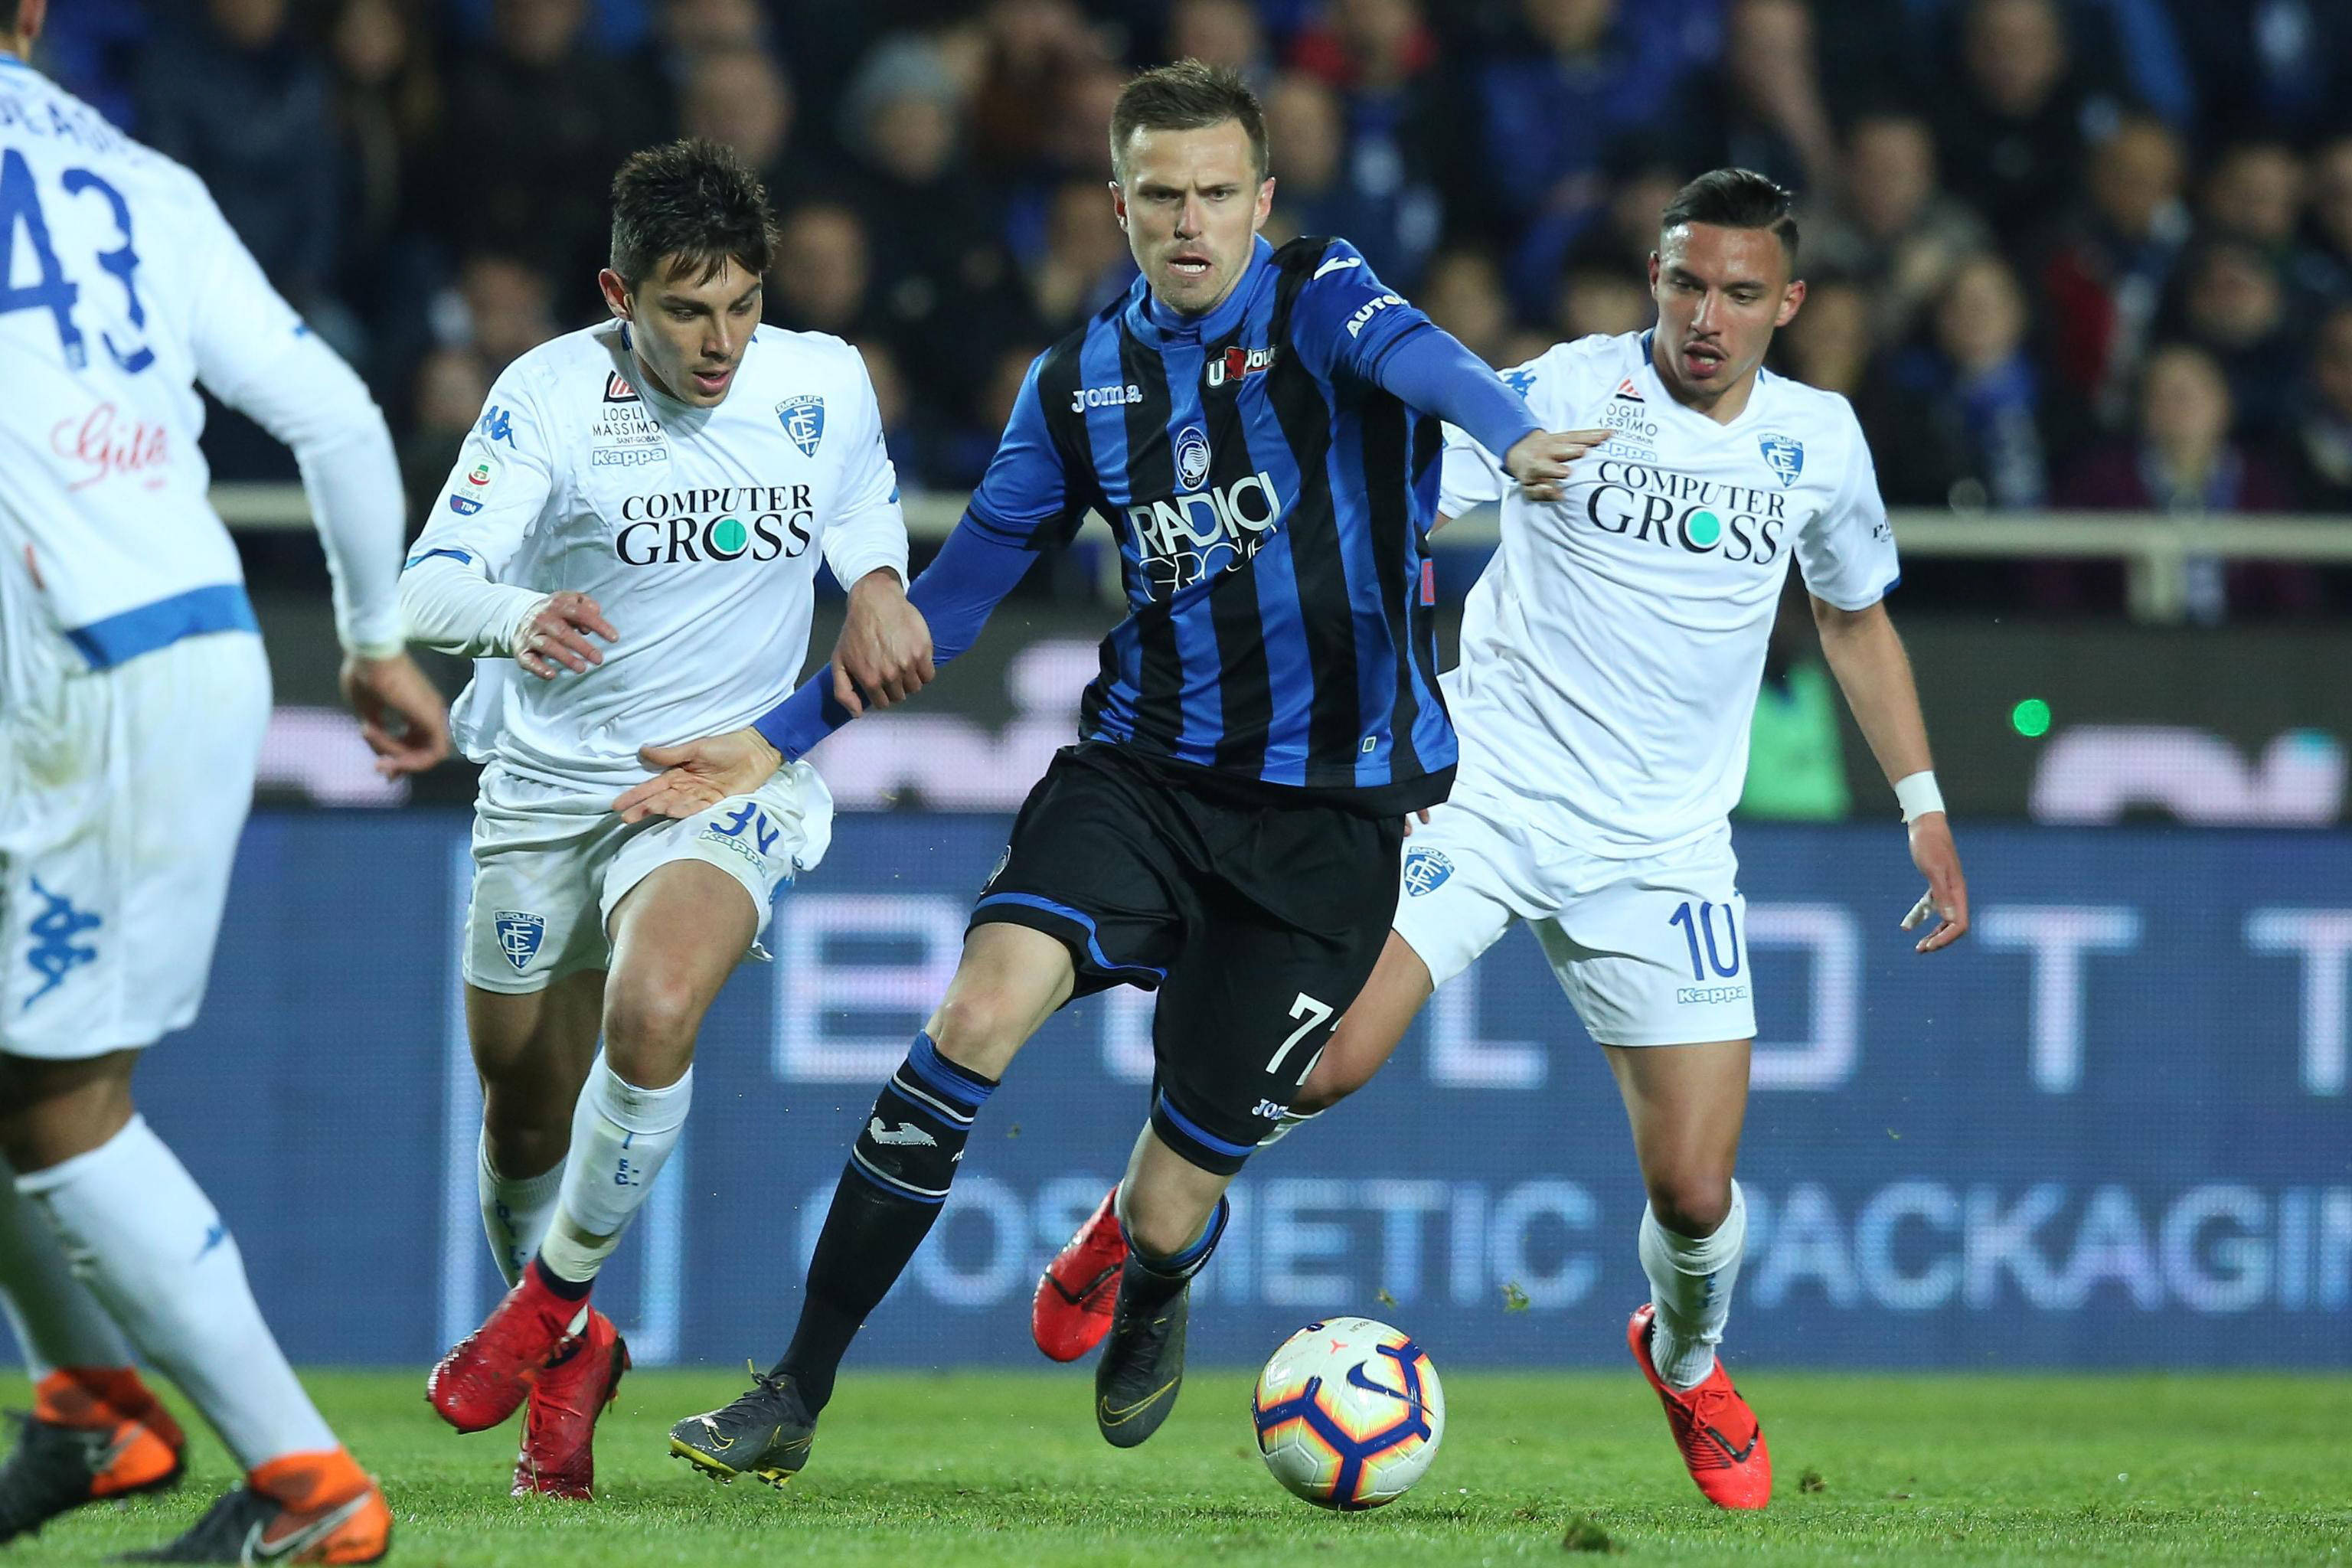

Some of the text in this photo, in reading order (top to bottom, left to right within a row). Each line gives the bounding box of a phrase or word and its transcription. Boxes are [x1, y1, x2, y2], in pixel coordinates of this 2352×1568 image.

[0, 148, 155, 374] 43
[593, 420, 660, 436] MASSIMO
[603, 406, 645, 421] LOGLI
[1597, 417, 1658, 436] ASSIMO
[1606, 403, 1645, 418] OGLI
[592, 448, 668, 466] Kappa
[622, 484, 812, 521] COMPUTER
[1127, 471, 1282, 559] RADICI
[1598, 460, 1785, 519] COMPUTER
[616, 510, 814, 565] GROSS
[1586, 485, 1784, 565] GROSS
[699, 829, 766, 878] Kappa
[1668, 901, 1740, 982] 10
[1677, 985, 1747, 1004] Kappa
[1265, 991, 1344, 1086] 7
[799, 1175, 1603, 1310] OETIC
